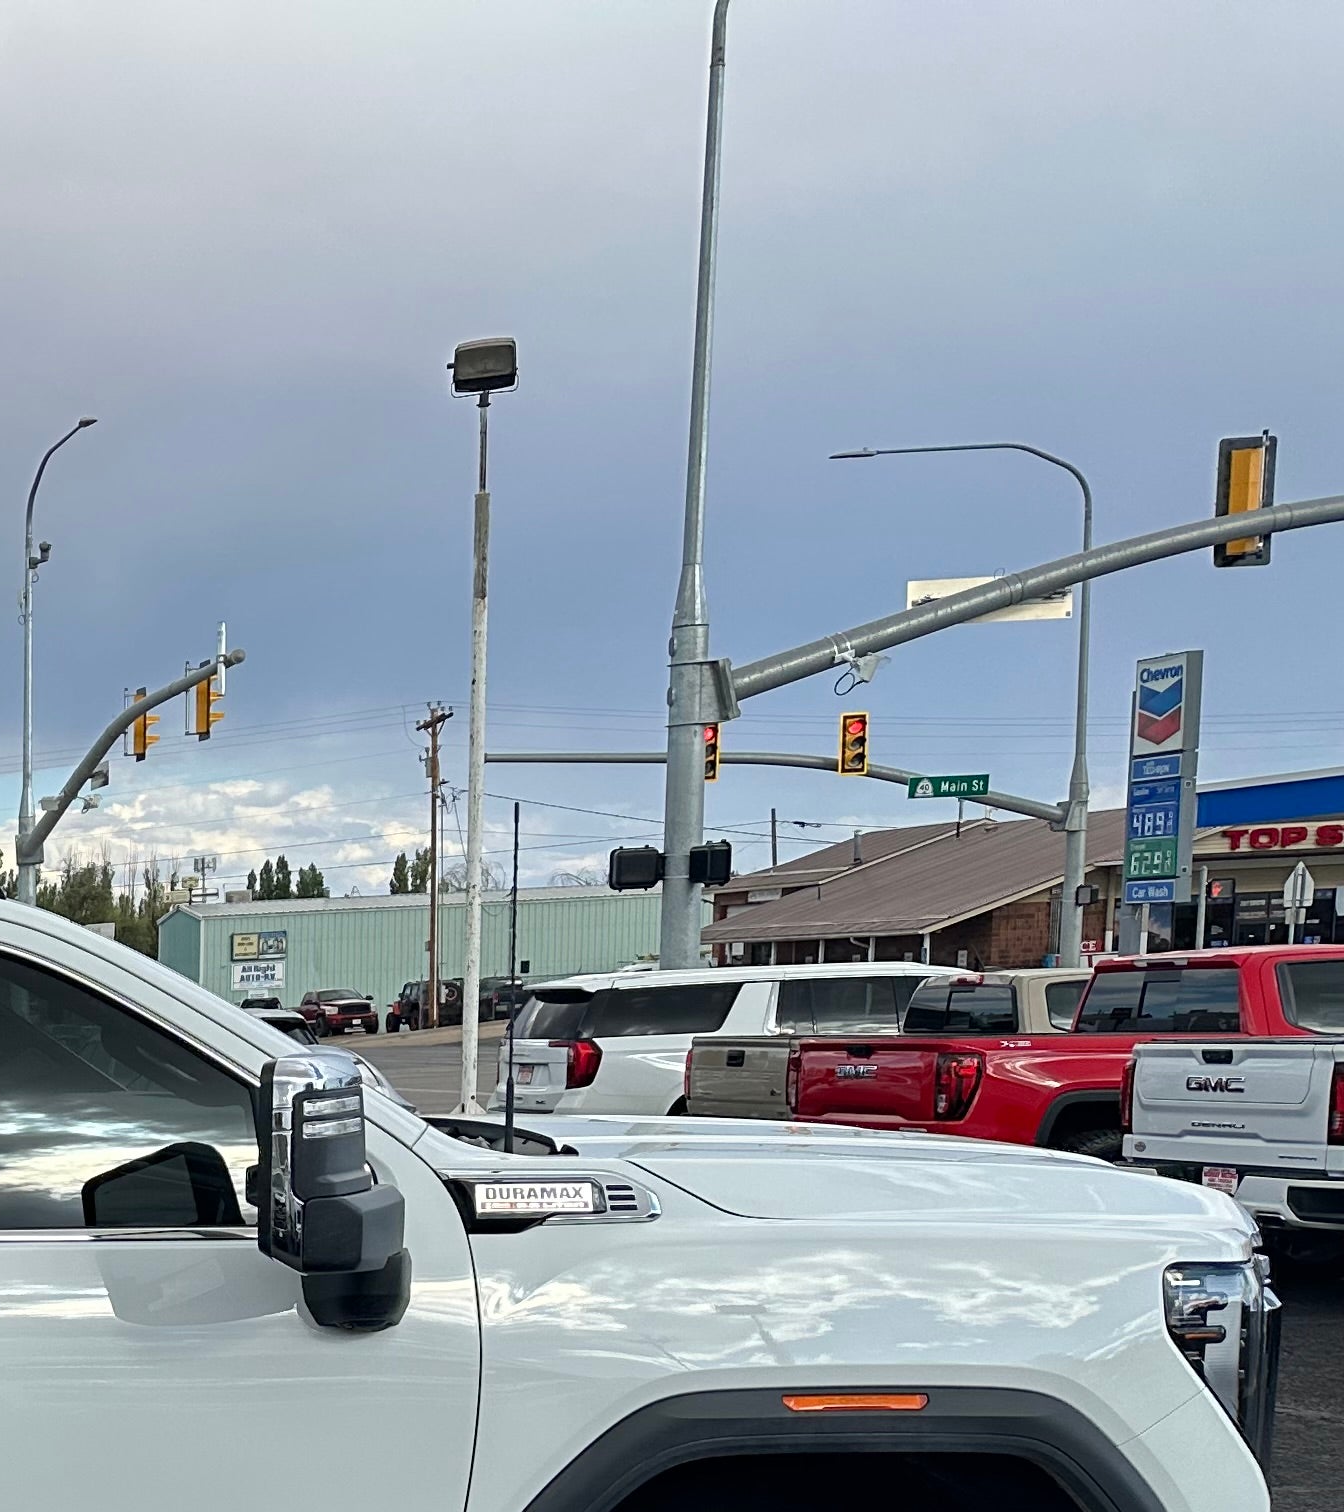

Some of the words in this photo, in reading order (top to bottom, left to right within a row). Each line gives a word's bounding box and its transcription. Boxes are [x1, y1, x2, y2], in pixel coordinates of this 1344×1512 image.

[1140, 664, 1183, 683] Chevron
[919, 783, 929, 791] 40
[940, 780, 968, 793] Main
[972, 779, 984, 791] St
[1221, 826, 1308, 851] TOP
[1132, 886, 1146, 899] Car
[1147, 885, 1169, 899] Wash
[1080, 940, 1097, 951] CE
[1186, 1076, 1246, 1093] GMC
[1191, 1121, 1245, 1129] DENALI
[485, 1186, 584, 1200] DURAMAX
